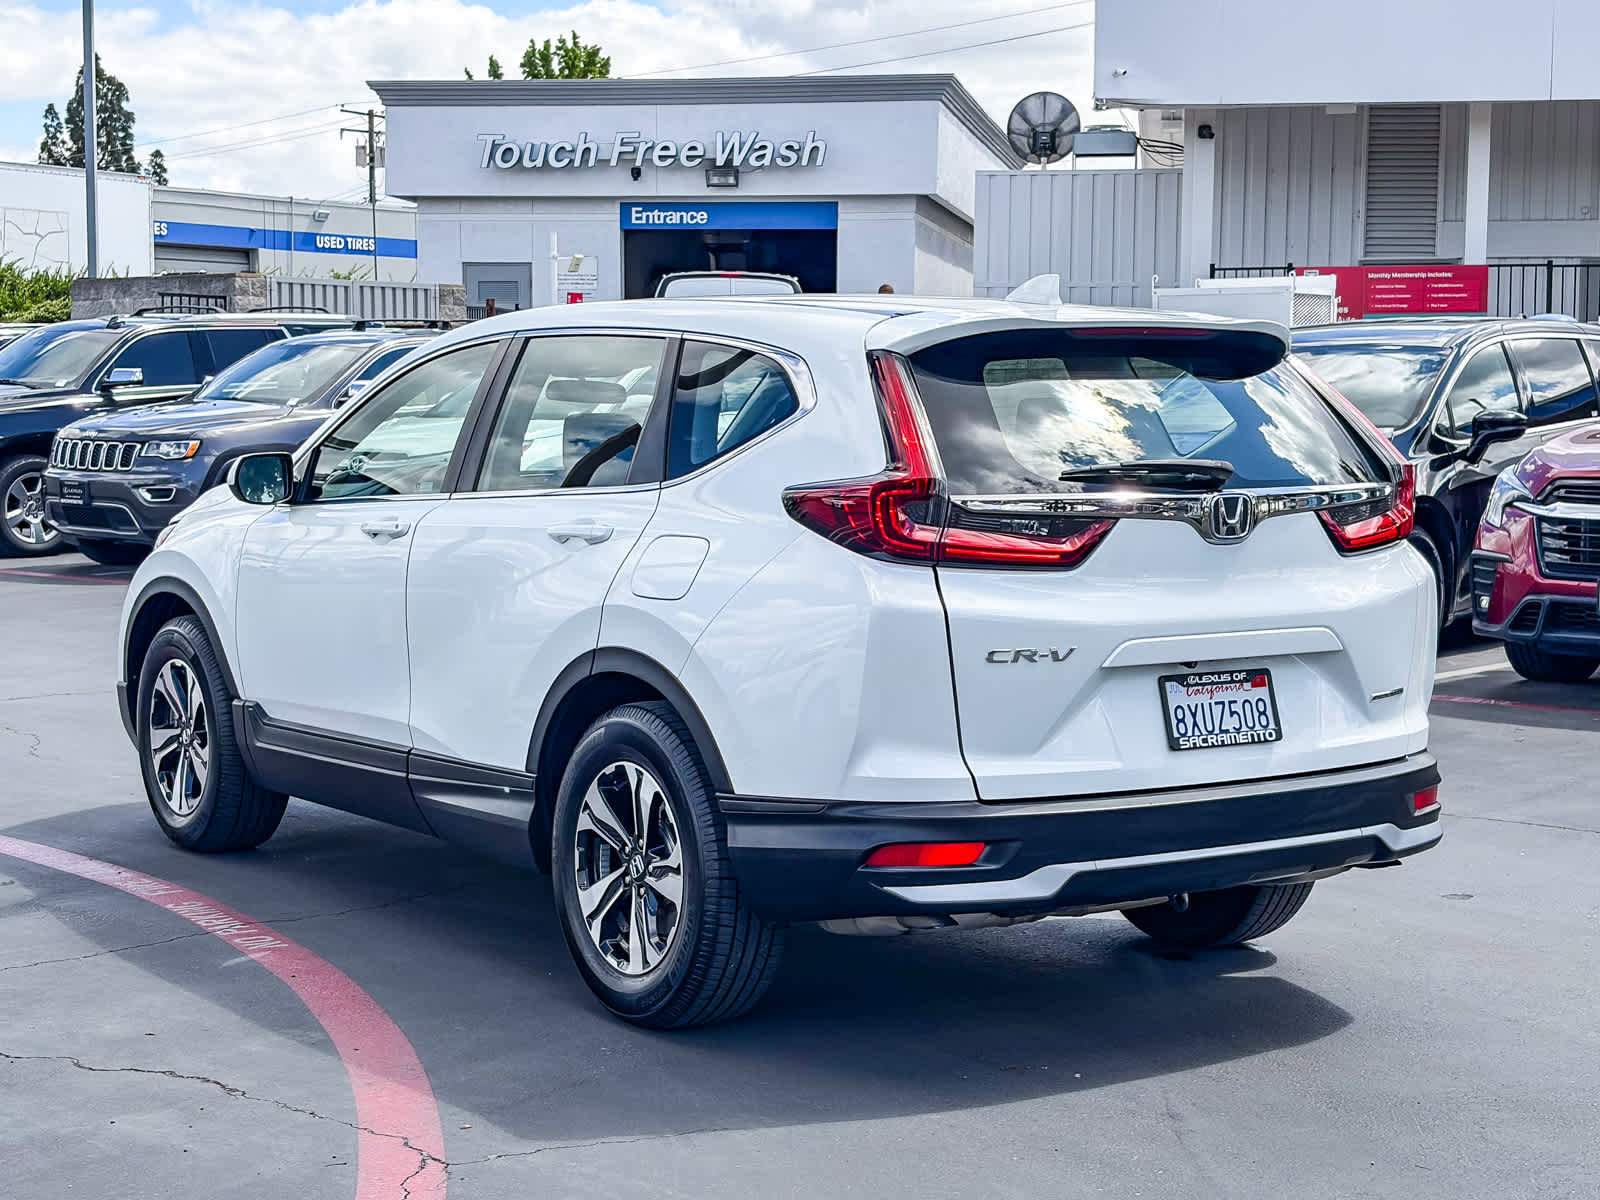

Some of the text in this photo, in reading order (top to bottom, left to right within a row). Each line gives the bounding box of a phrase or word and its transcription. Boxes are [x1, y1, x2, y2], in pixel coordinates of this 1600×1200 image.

[477, 131, 828, 169] Touch Free Wash
[631, 207, 708, 224] Entrance
[316, 235, 376, 250] USED TIRES
[985, 646, 1079, 664] CR-V
[1195, 672, 1248, 683] LEXUS OF
[1174, 697, 1271, 738] 8XUZ508
[1179, 729, 1277, 750] SACRAMENTO
[165, 900, 289, 951] NO PARKING
